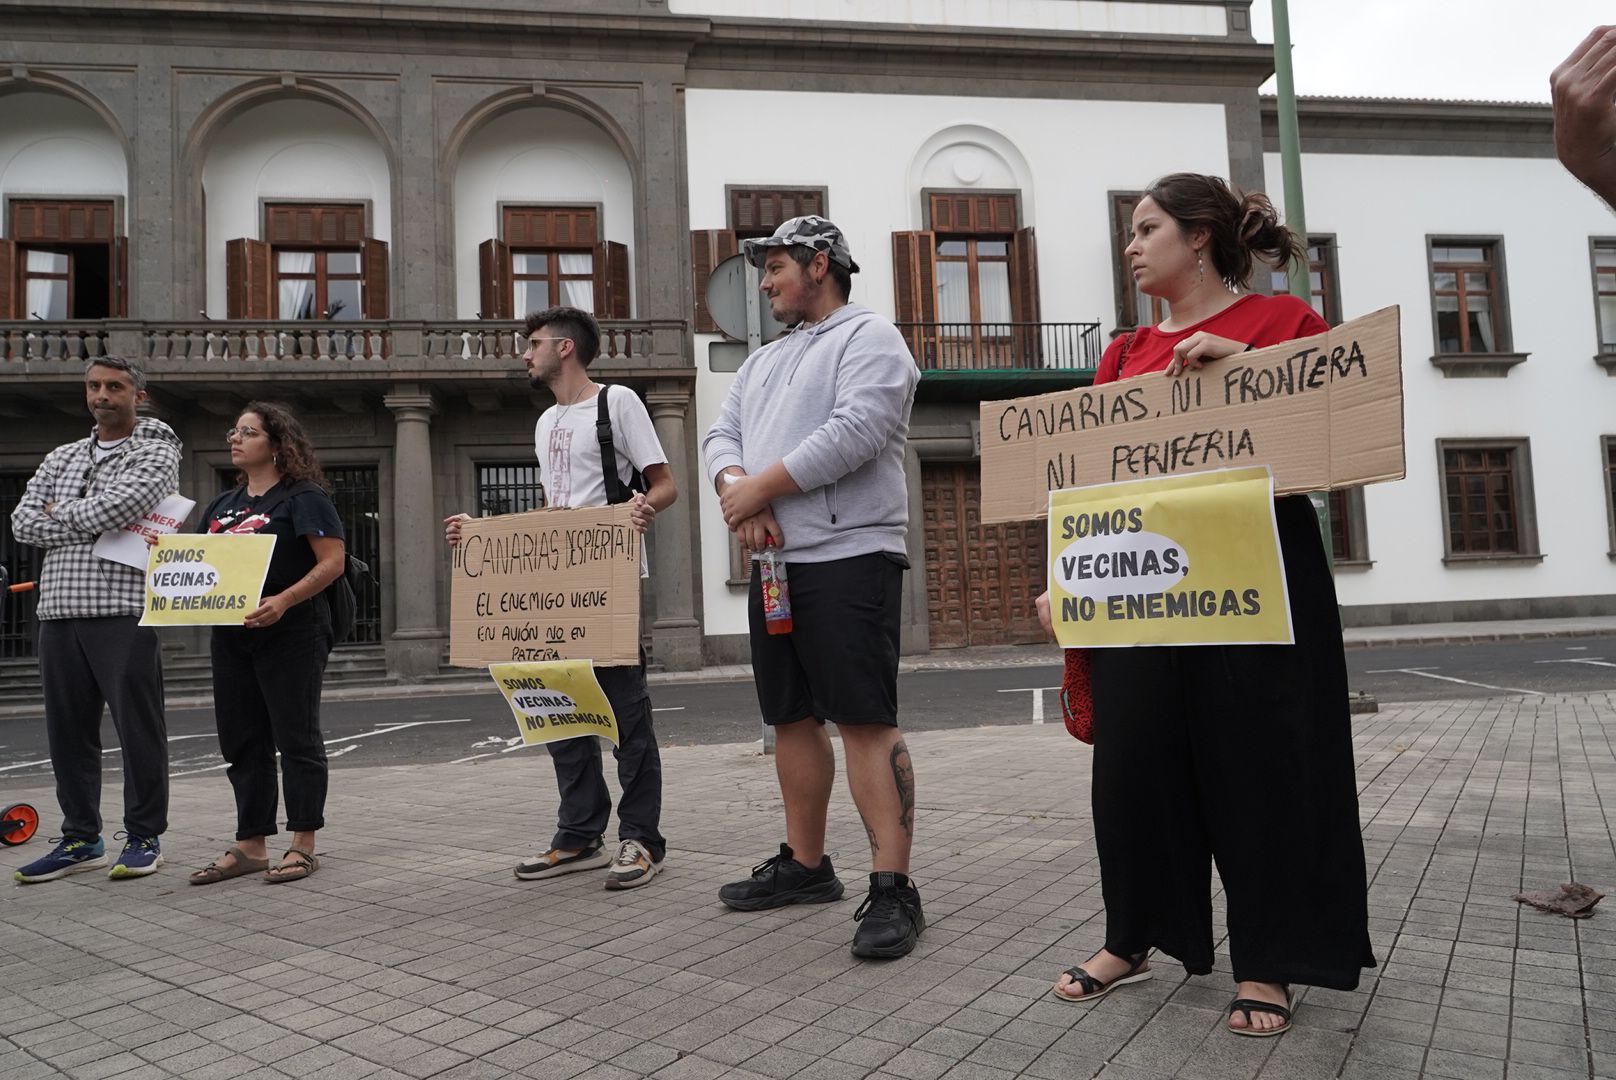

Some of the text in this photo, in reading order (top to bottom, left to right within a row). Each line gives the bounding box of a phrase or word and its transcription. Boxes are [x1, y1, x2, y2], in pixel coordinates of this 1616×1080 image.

[1000, 340, 1368, 441] CANARIAS, NI FRONTERA
[1048, 428, 1255, 491] NI PERIFERIA
[1061, 507, 1143, 540] SOMOS
[156, 548, 205, 563] SOMOS
[1061, 548, 1189, 580] VECINAS,
[153, 572, 218, 587] VECINAS,
[151, 595, 247, 611] NO ENEMIGAS
[476, 591, 607, 617] EL ENEMIGO VIENE
[1062, 588, 1261, 622] NO ENEMIGAS
[477, 625, 495, 642] EN
[501, 621, 538, 641] AVIÓN
[545, 625, 564, 640] NO
[503, 677, 546, 690] SOMOS
[513, 695, 578, 709] VECINAS,
[525, 713, 612, 731] NO ENEMIGAS
